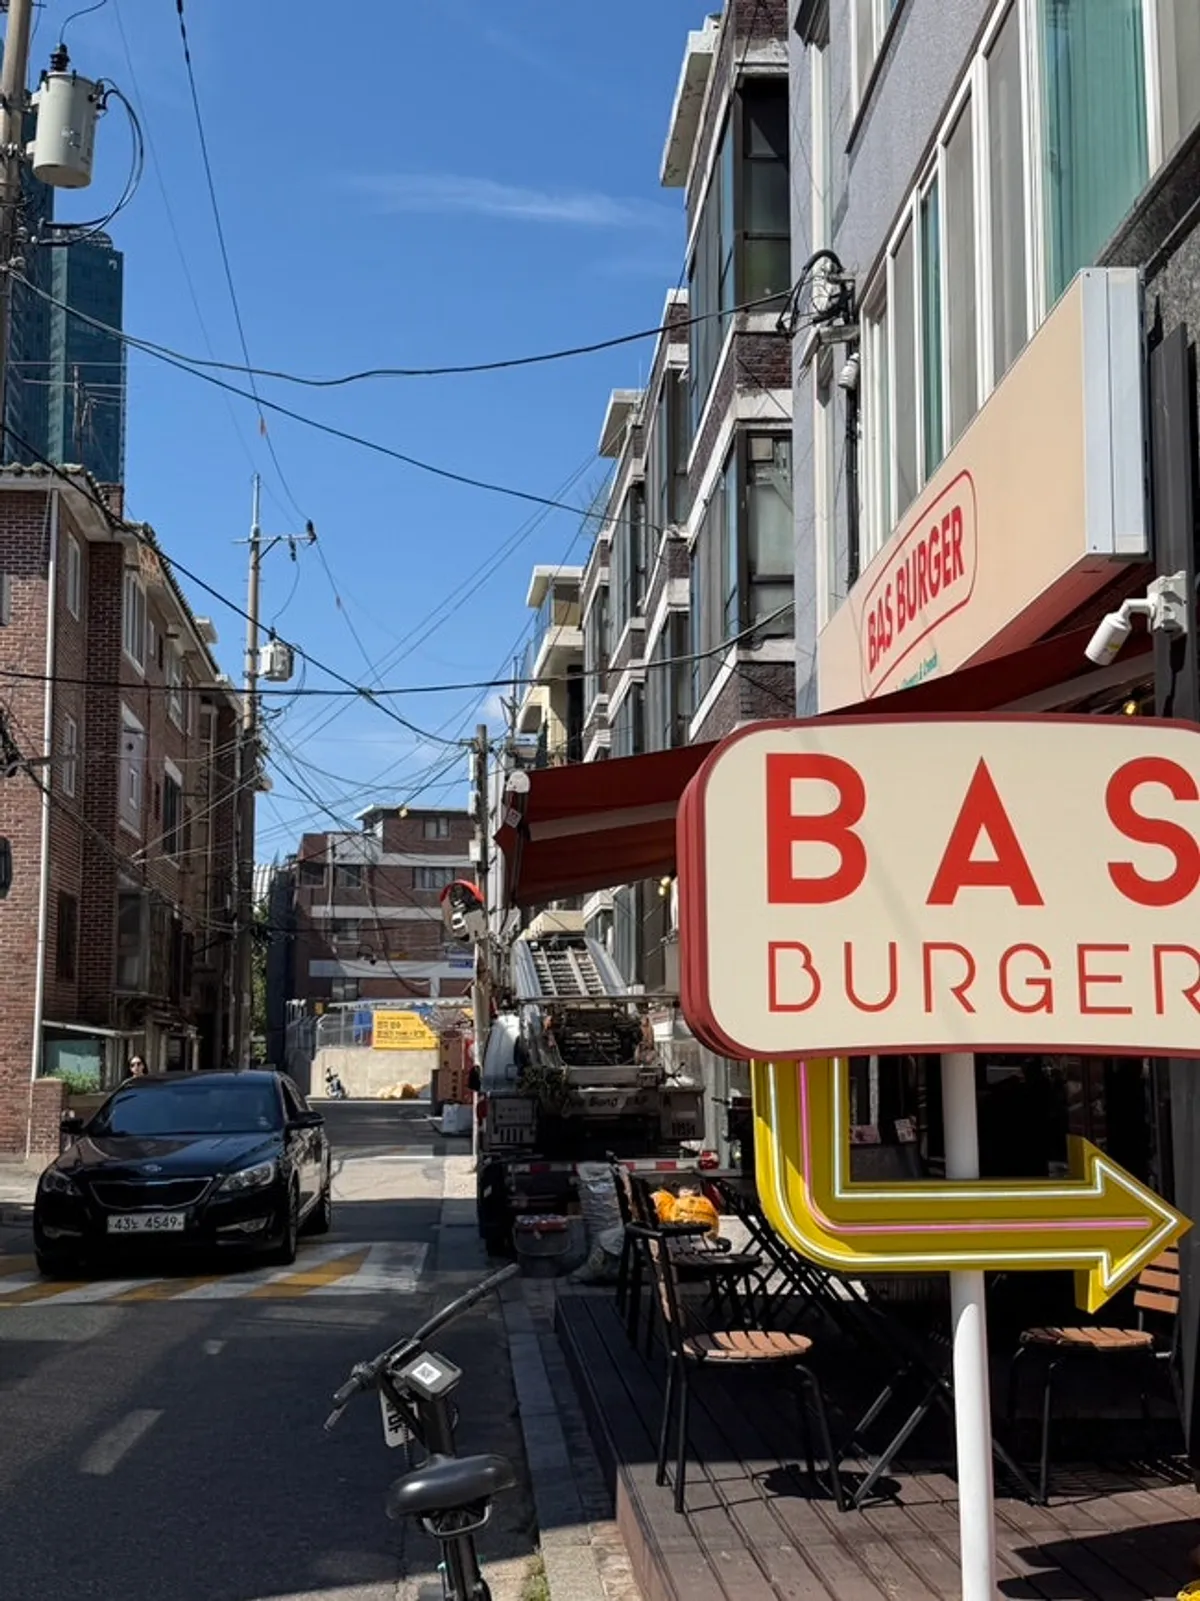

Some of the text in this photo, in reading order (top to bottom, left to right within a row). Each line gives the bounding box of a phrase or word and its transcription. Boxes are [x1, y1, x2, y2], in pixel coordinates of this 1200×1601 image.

[868, 584, 893, 673] BAS
[896, 505, 965, 635] BURGER
[766, 753, 1200, 906] BAS
[768, 941, 1200, 1014] BURGER
[144, 1215, 178, 1229] 4549
